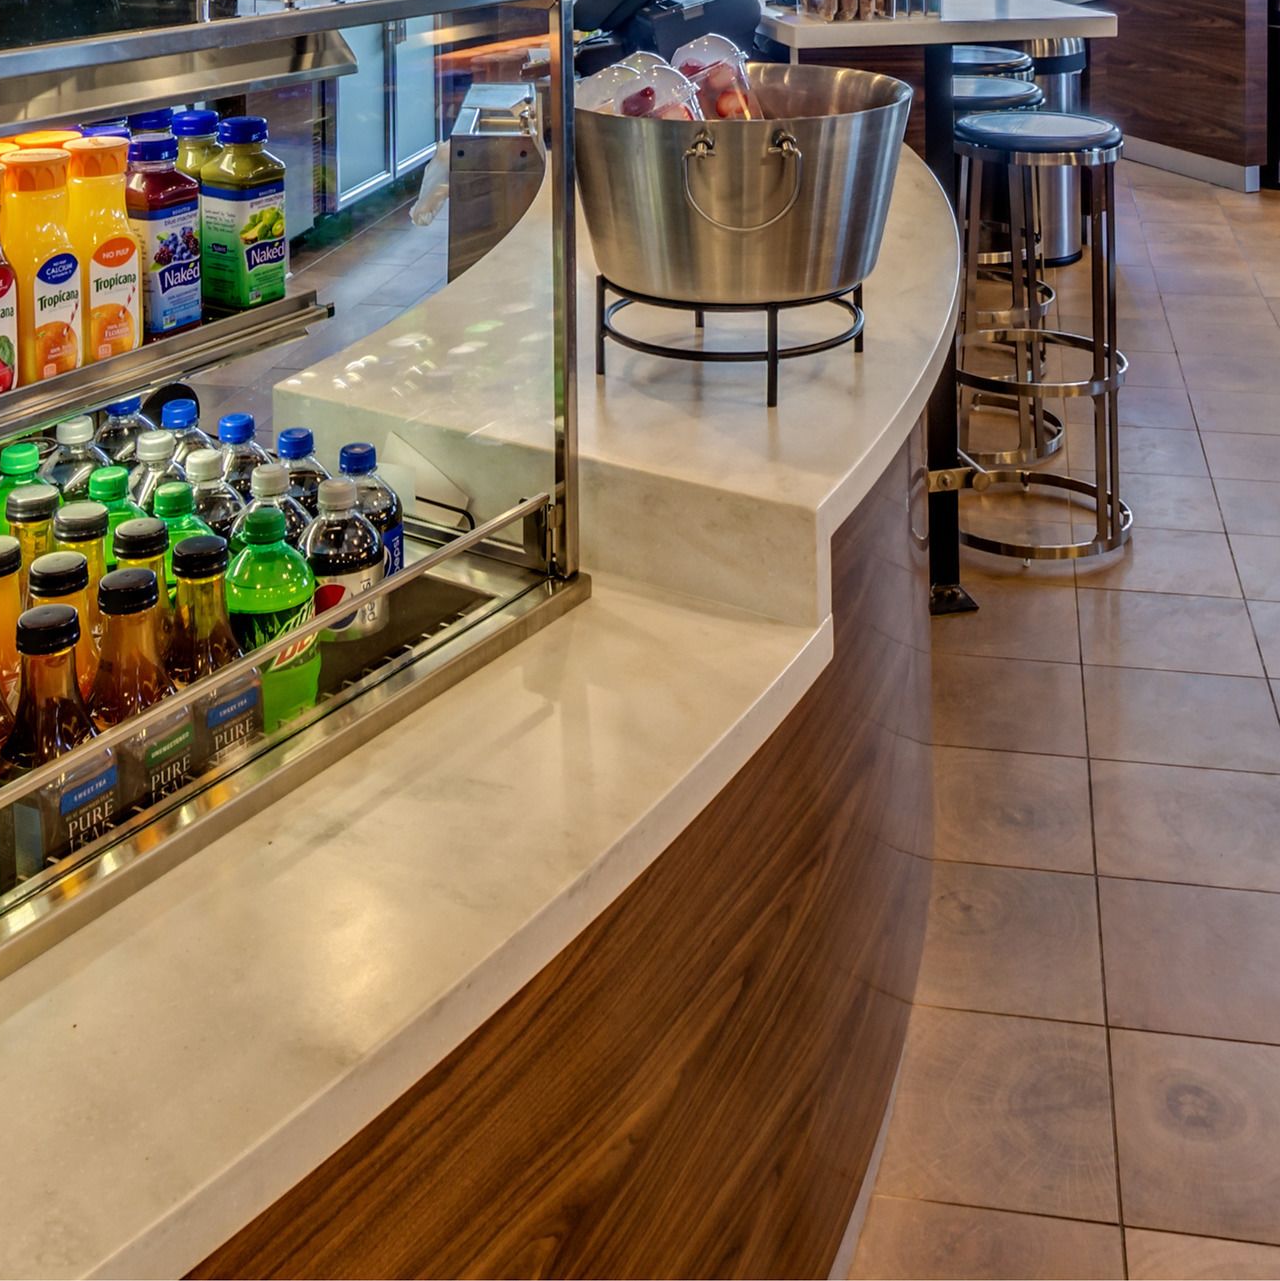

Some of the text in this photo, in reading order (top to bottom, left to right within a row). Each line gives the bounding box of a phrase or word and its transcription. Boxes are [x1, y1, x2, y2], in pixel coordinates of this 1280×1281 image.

[102, 248, 129, 259] NO PULP
[251, 243, 285, 266] Naked
[46, 263, 72, 276] CALCIUM
[164, 263, 200, 287] Naked
[94, 273, 136, 292] Tropicana
[38, 290, 79, 311] Tropicana
[237, 698, 248, 709] TEA
[214, 719, 254, 750] PURE
[151, 756, 191, 791] PURE
[74, 779, 107, 801] SWEET TEA
[68, 799, 114, 838] PURE
